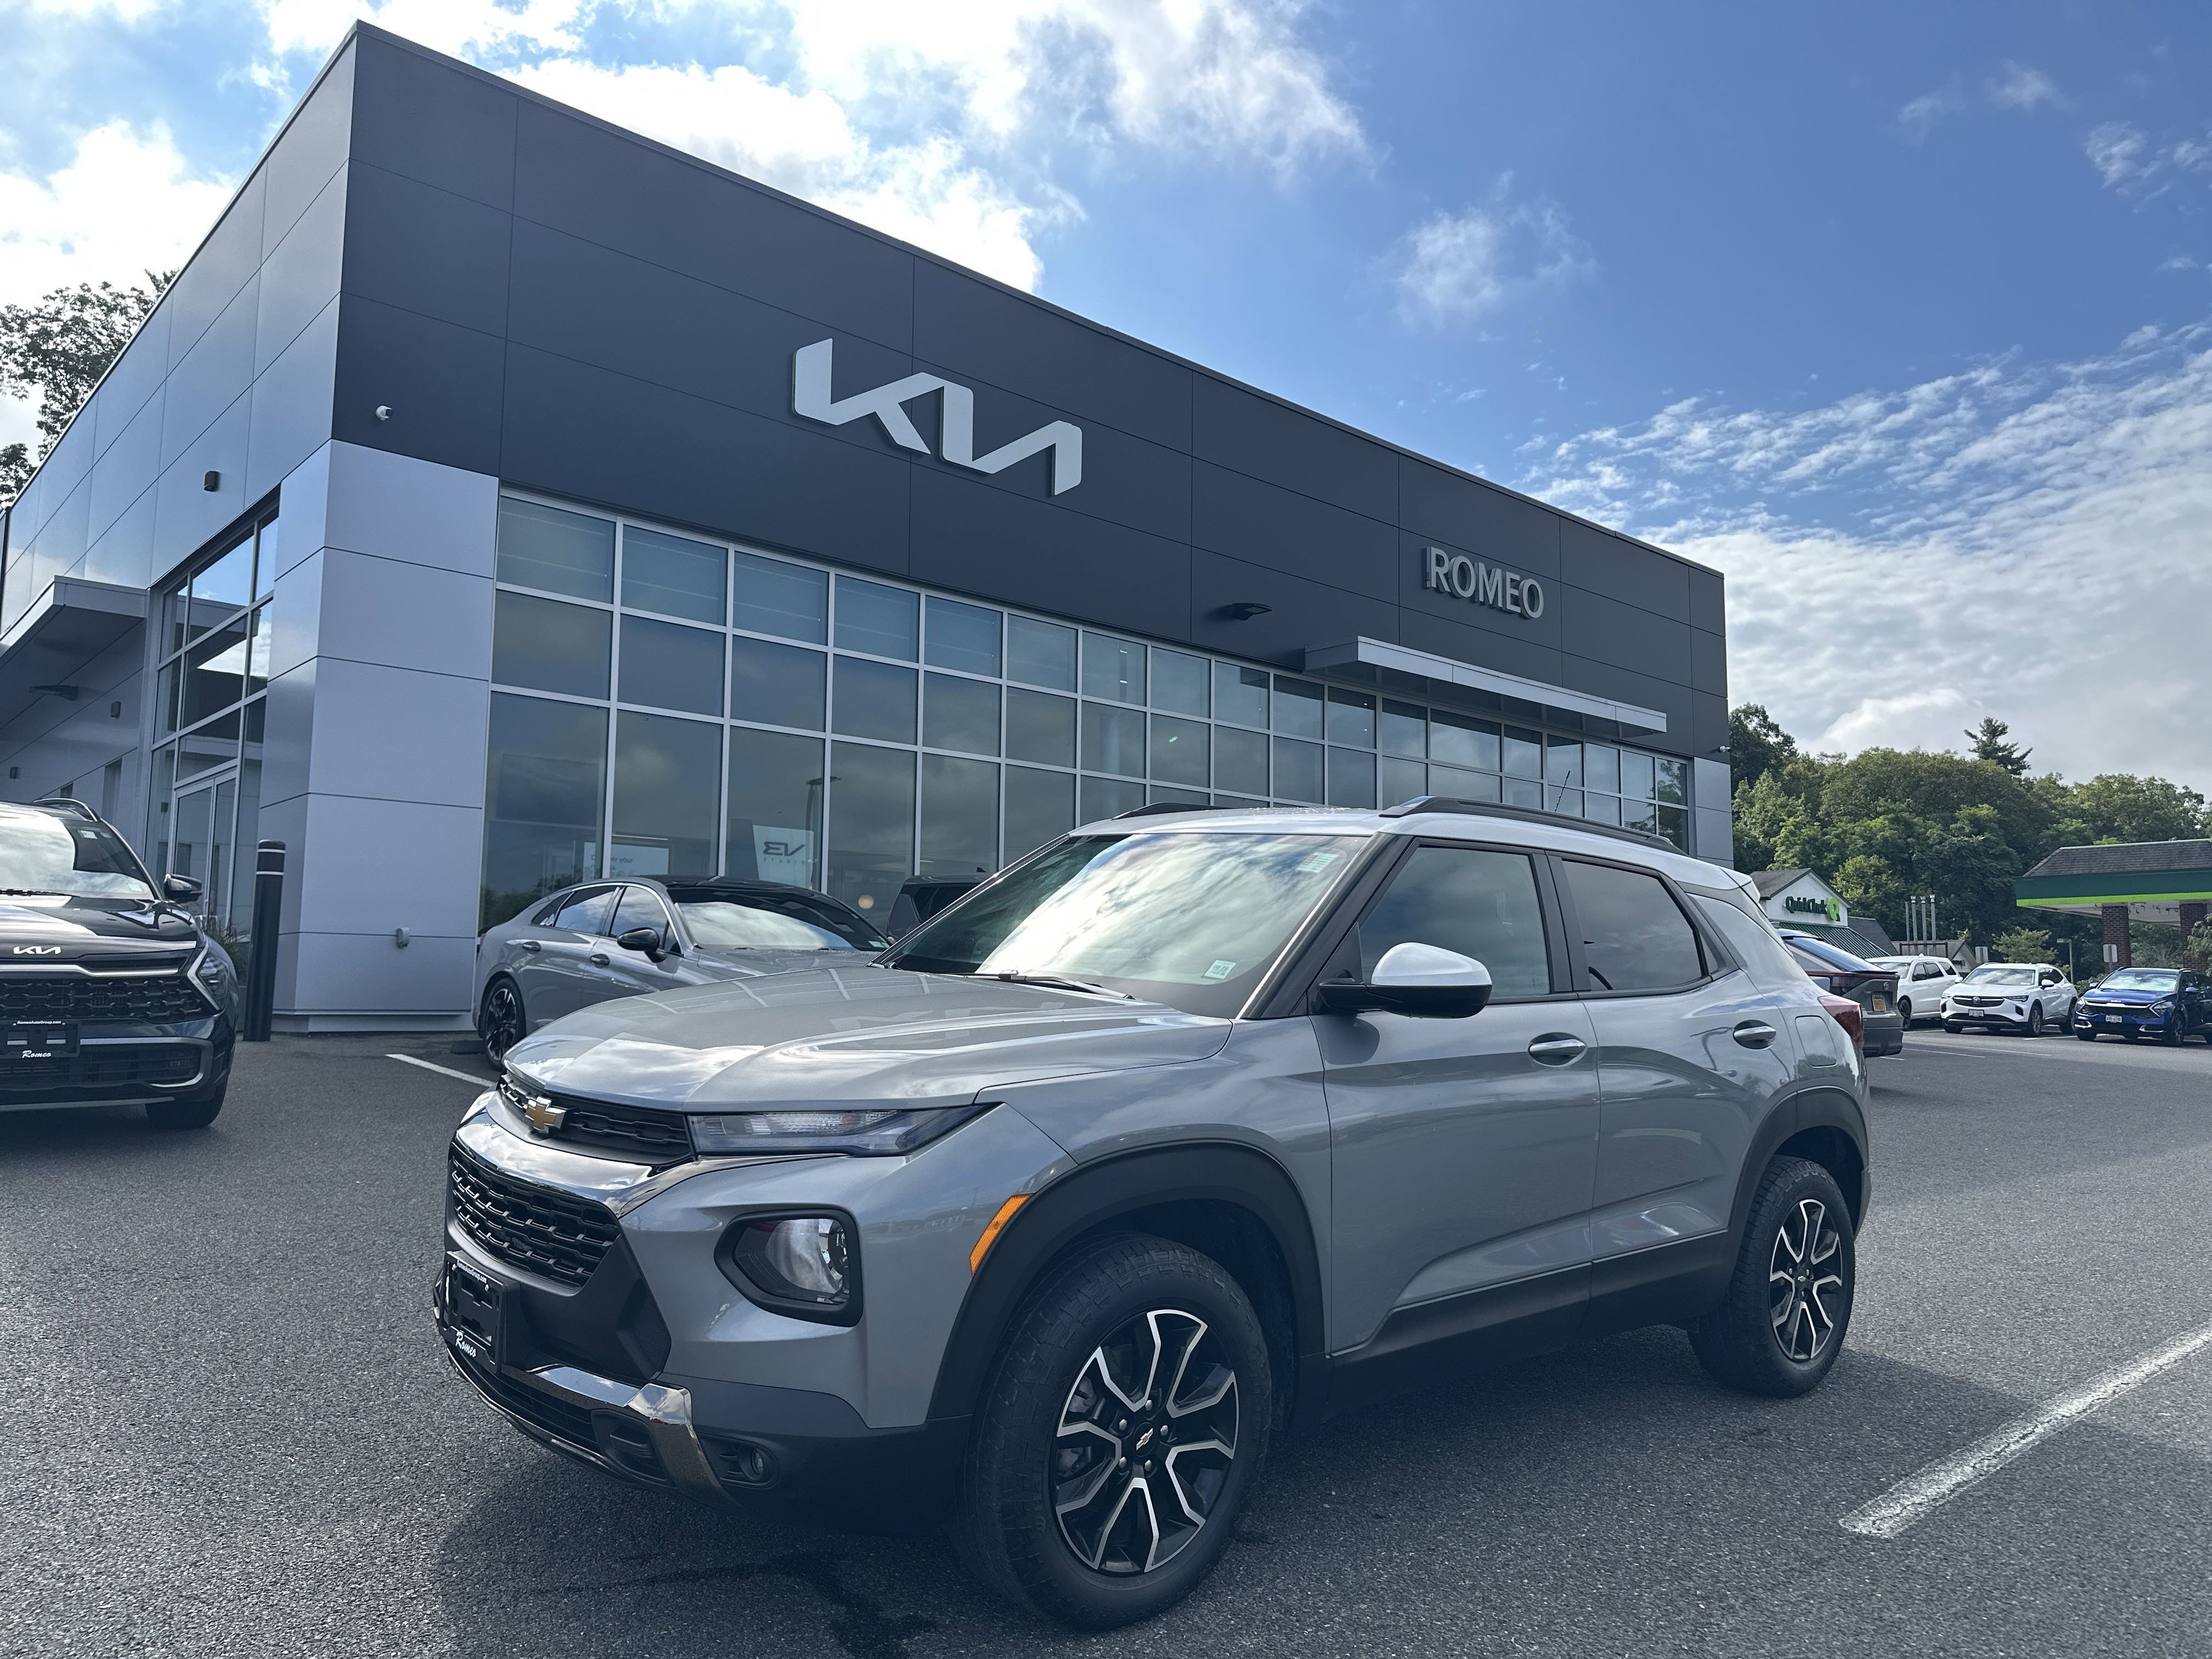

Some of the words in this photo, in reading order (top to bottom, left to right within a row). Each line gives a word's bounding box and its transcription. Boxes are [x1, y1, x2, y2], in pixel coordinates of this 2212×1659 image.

[792, 338, 1082, 495] KIA
[1426, 546, 1544, 619] ROMEO
[763, 841, 806, 856] EV
[13, 946, 61, 955] KIA
[22, 1050, 52, 1058] Romeo
[455, 1330, 476, 1358] Romeo
